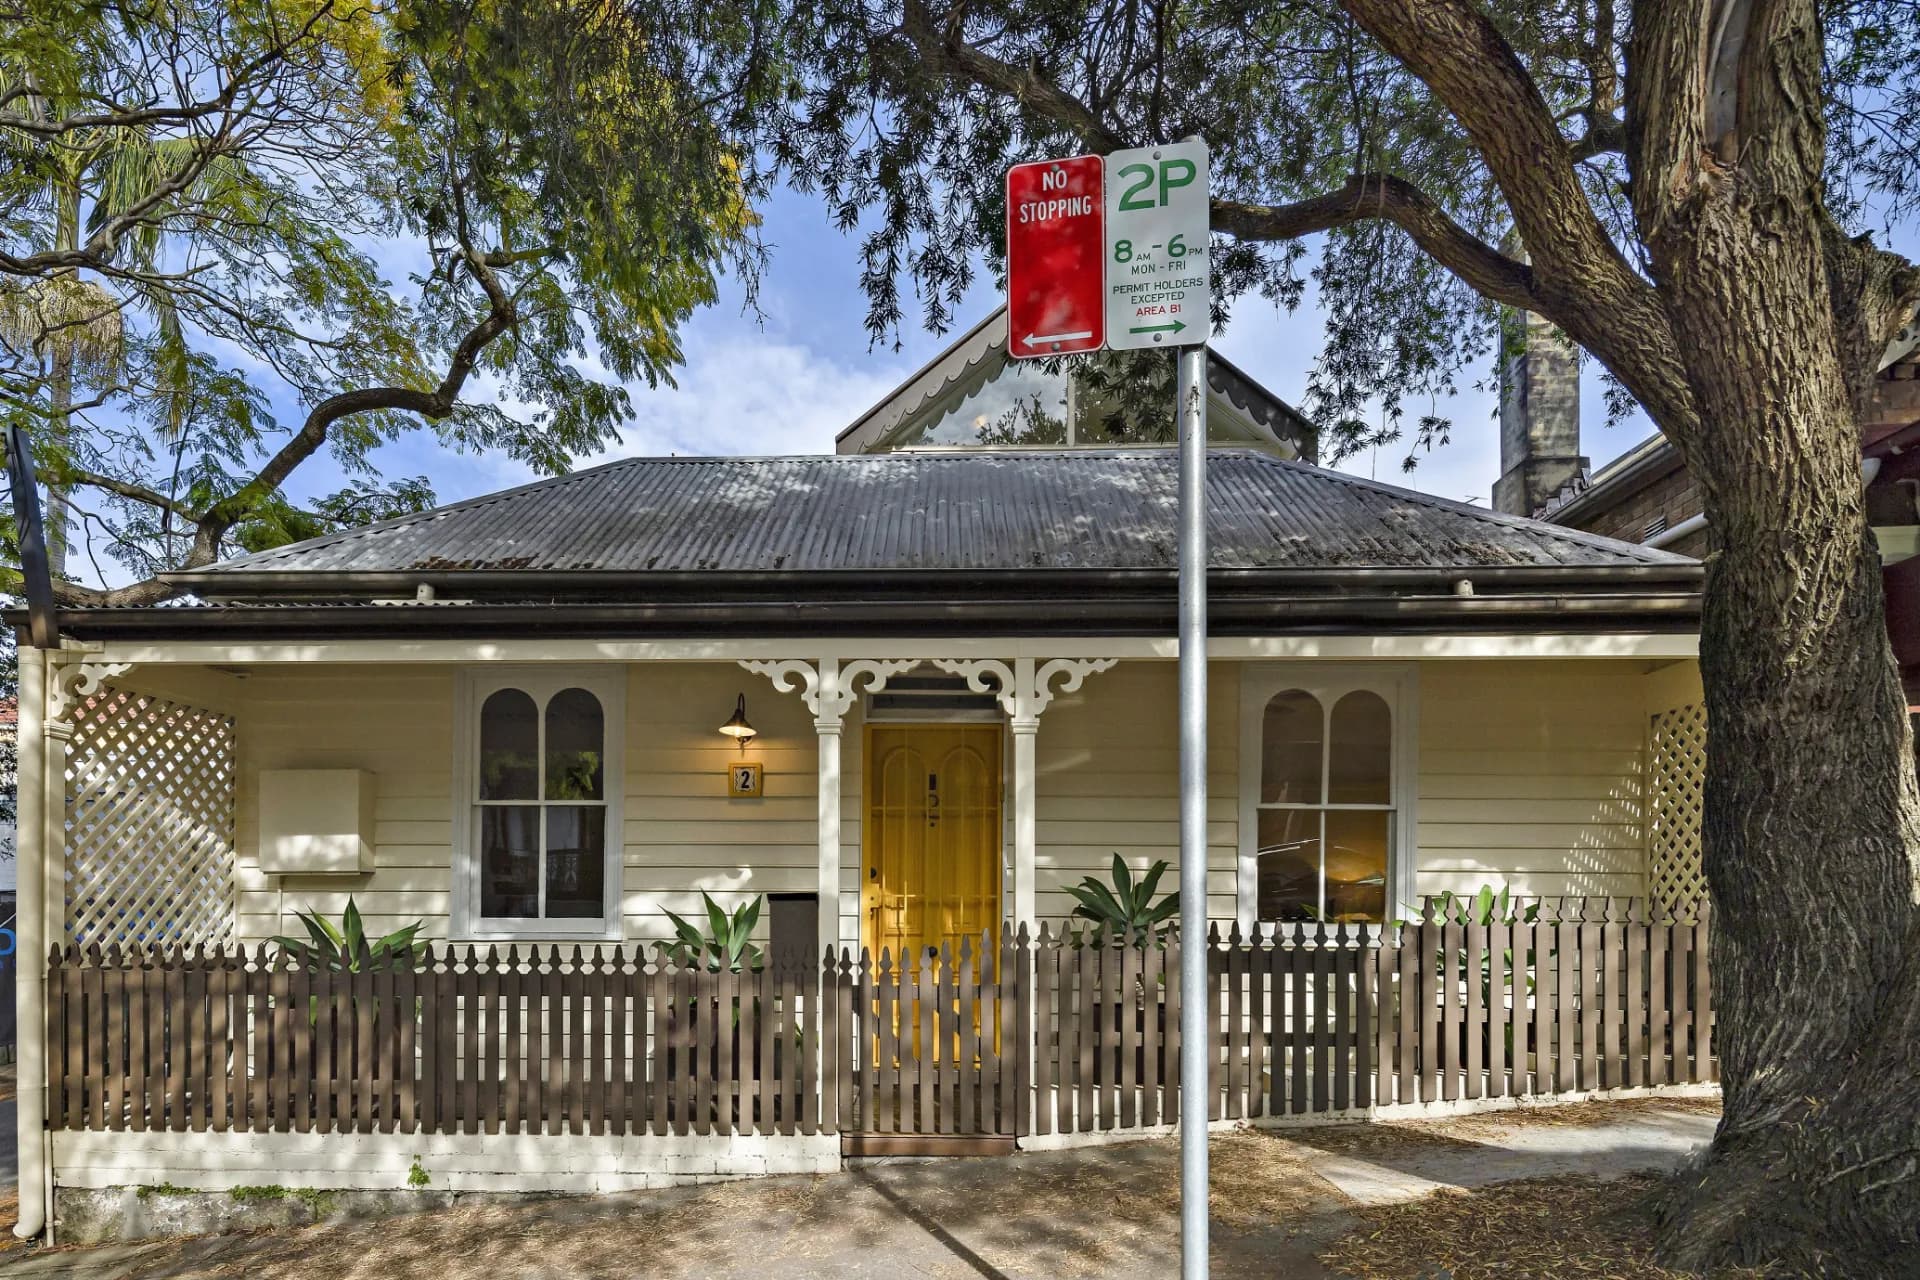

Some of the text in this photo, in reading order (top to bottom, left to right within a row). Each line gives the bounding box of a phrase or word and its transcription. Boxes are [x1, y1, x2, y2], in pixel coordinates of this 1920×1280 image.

[1042, 169, 1067, 191] NO
[1118, 158, 1197, 212] 2P
[1020, 195, 1091, 223] STOPPING
[1131, 263, 1156, 275] MON
[1168, 260, 1186, 271] FRI
[1113, 277, 1204, 295] PERMIT HOLDERS
[1131, 290, 1185, 305] EXCEPTED
[1136, 303, 1182, 317] AREA B1
[741, 770, 750, 789] 2
